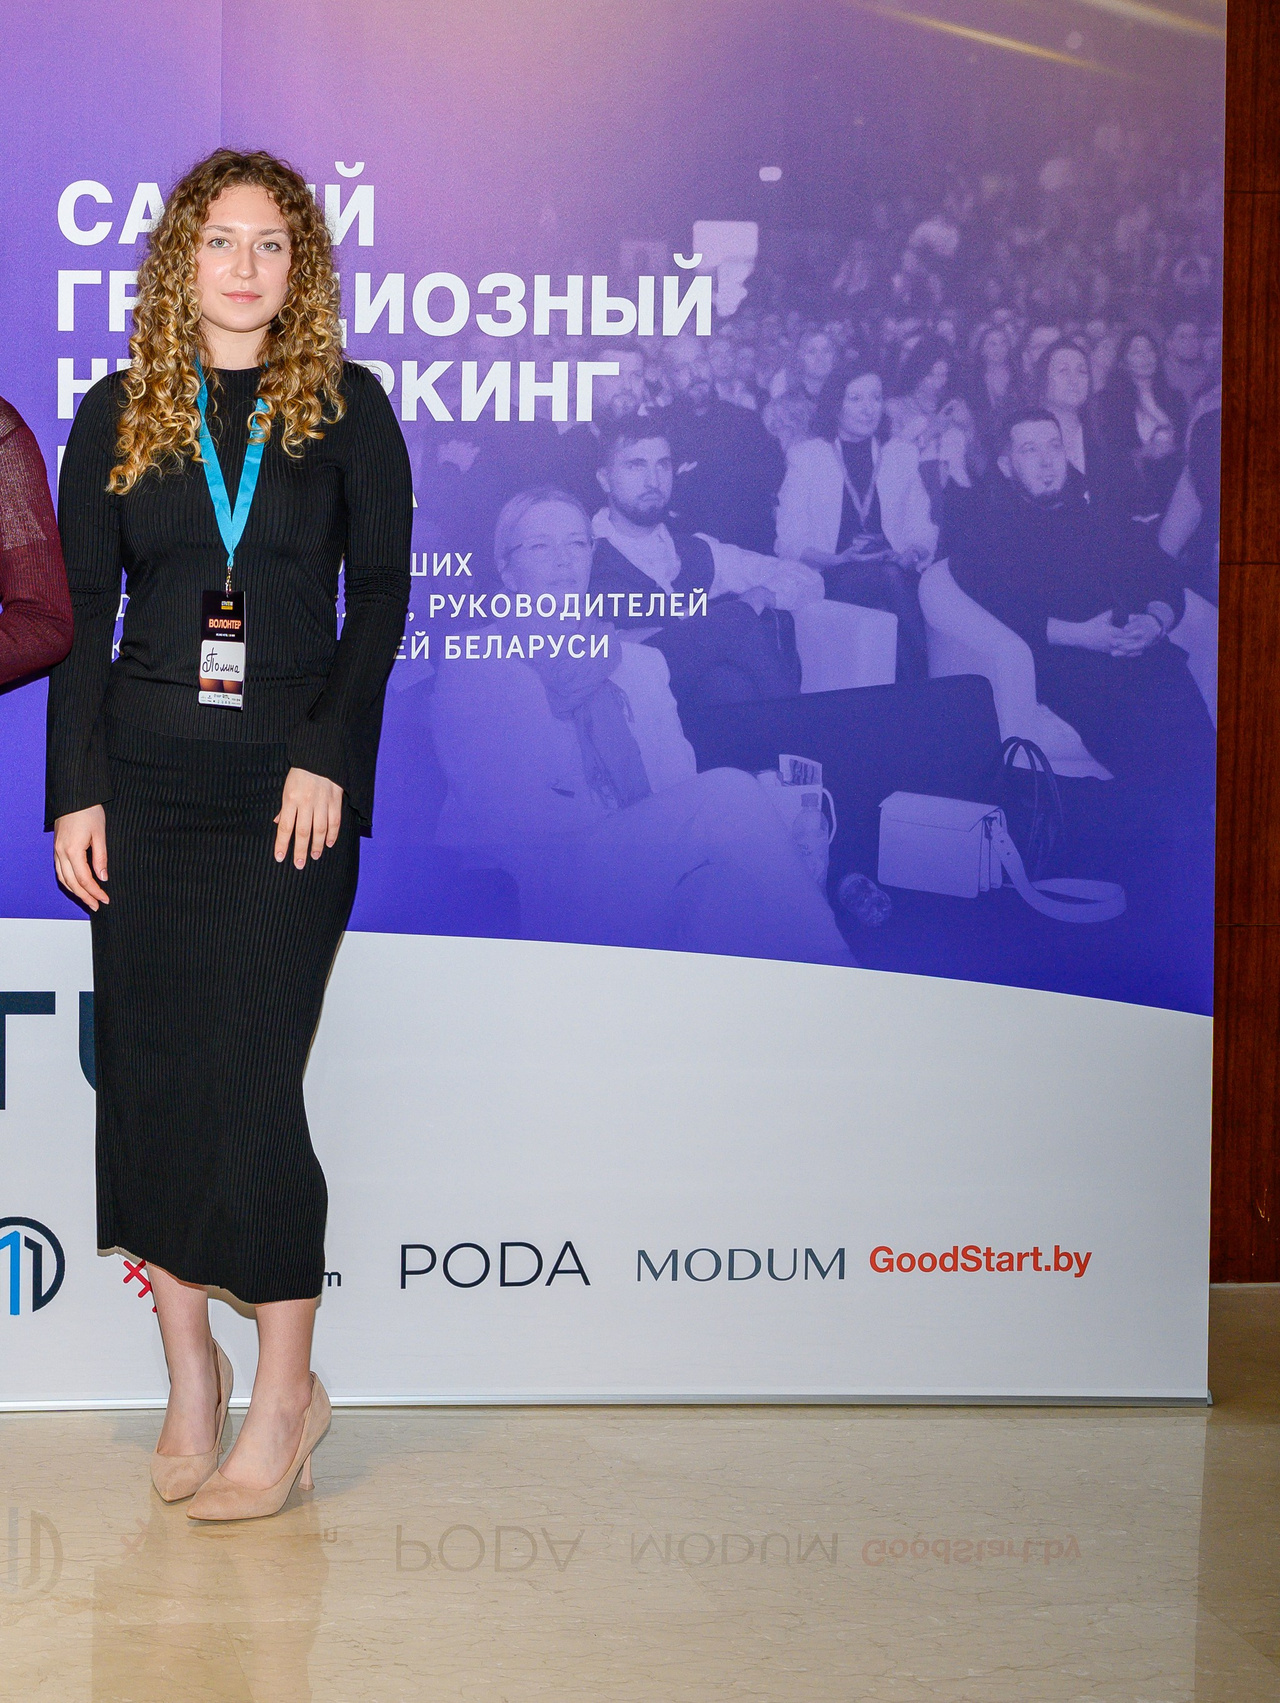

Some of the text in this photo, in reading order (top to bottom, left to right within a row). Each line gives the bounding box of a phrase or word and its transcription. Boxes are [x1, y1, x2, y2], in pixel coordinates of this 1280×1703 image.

[57, 161, 374, 246] САЙ
[58, 253, 713, 348] ГРИОЗНЫЙ
[430, 589, 707, 620] РУКОВОДИТЕЛЕЙ
[209, 619, 241, 629] ВОЛОНТЕР
[445, 635, 609, 660] БЕЛАРУСИ
[401, 1241, 591, 1289] PODA
[637, 1247, 846, 1282] MODUM
[869, 1245, 1093, 1277] GoodStart.by
